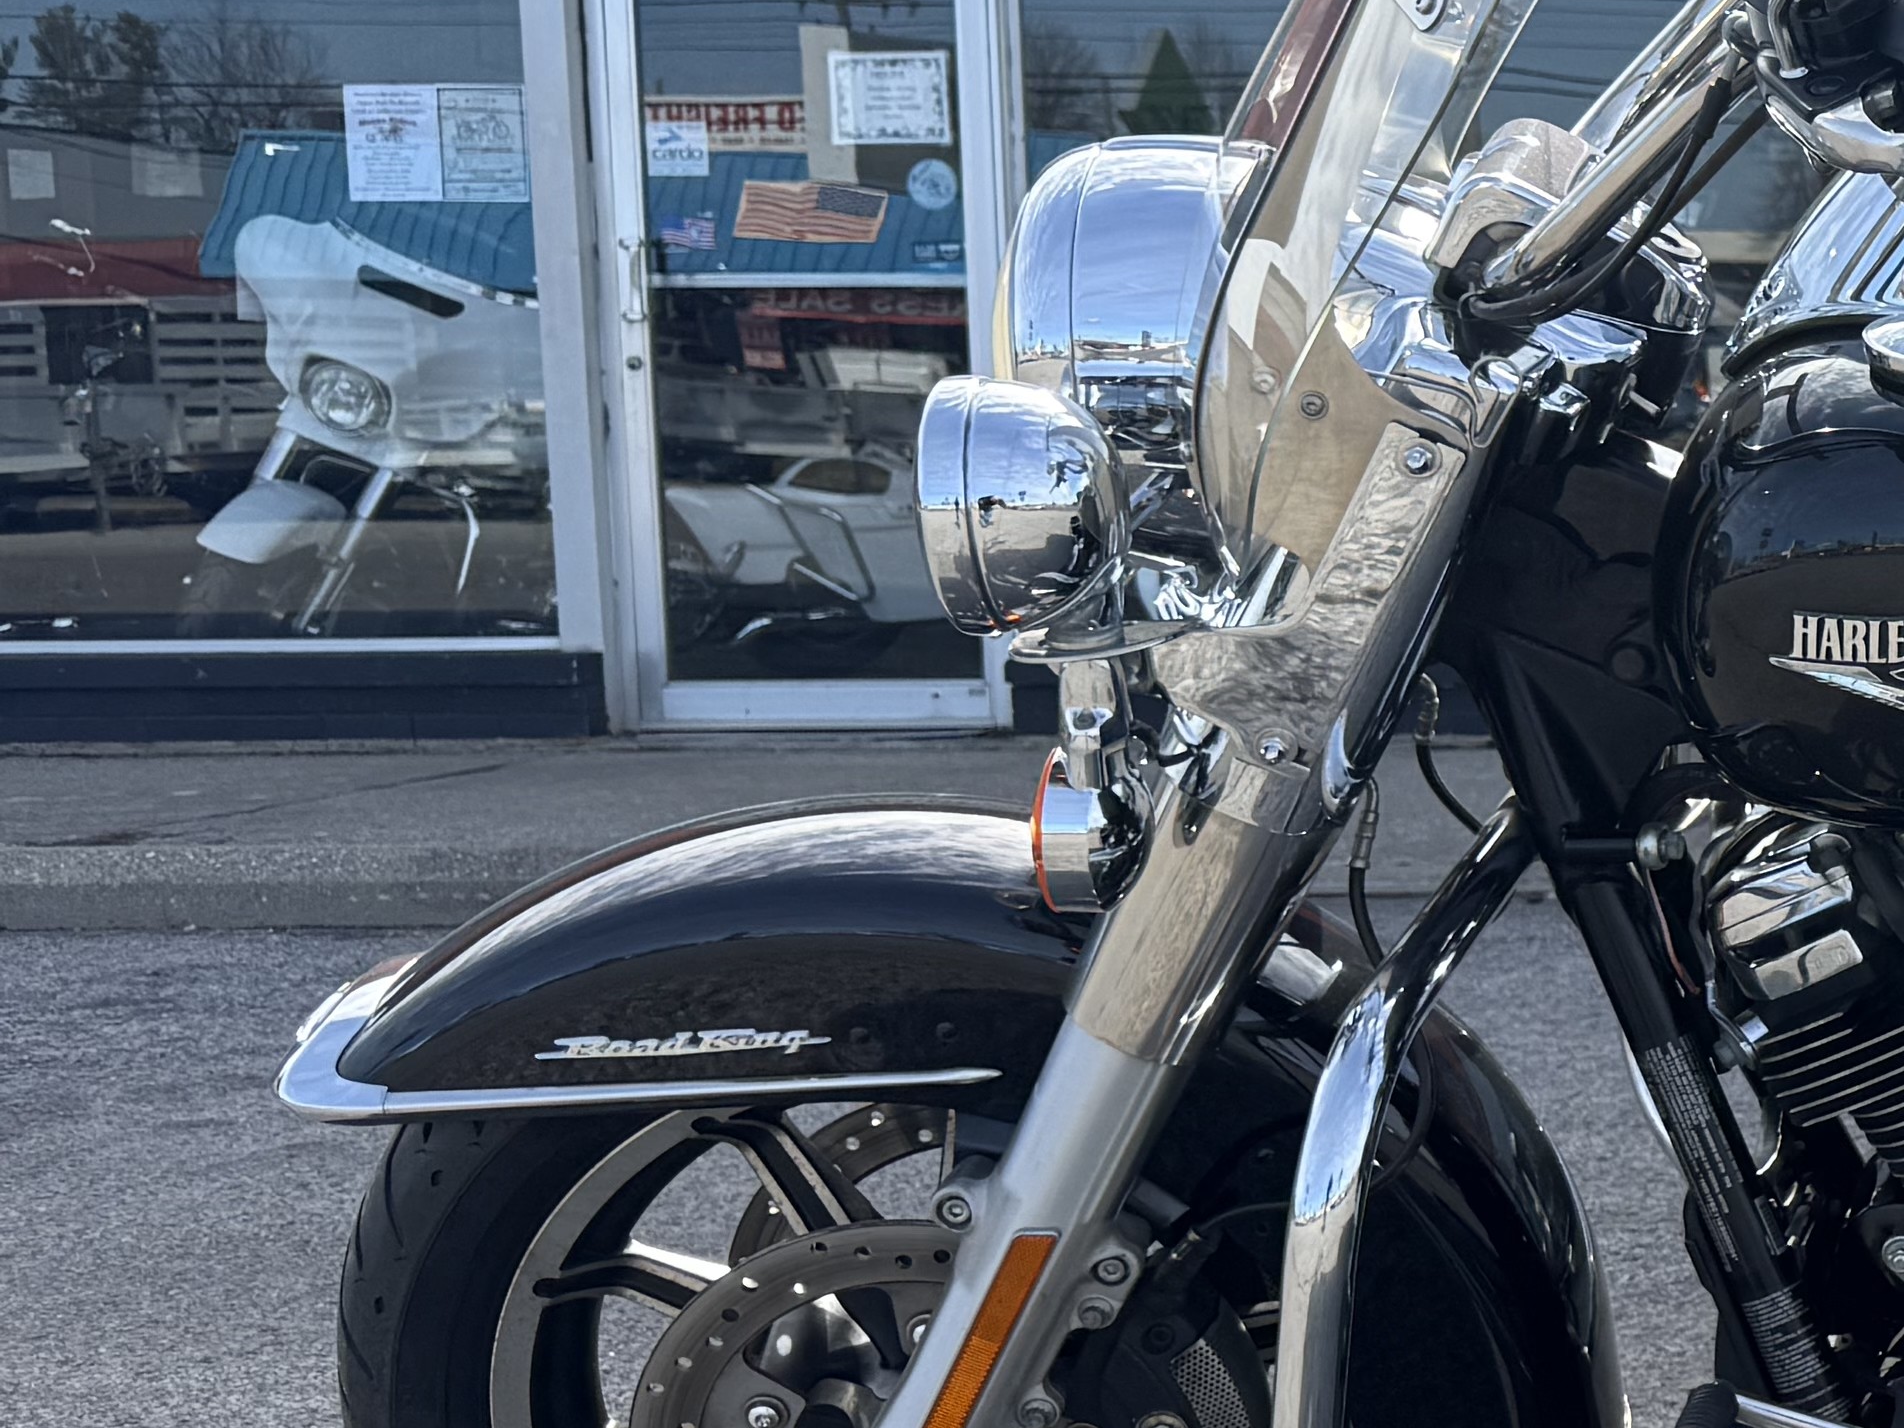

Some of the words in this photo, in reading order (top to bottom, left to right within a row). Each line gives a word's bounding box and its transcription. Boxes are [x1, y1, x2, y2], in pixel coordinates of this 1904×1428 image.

[652, 142, 705, 162] cardo
[553, 1031, 694, 1060] Road
[697, 1028, 812, 1055] King
